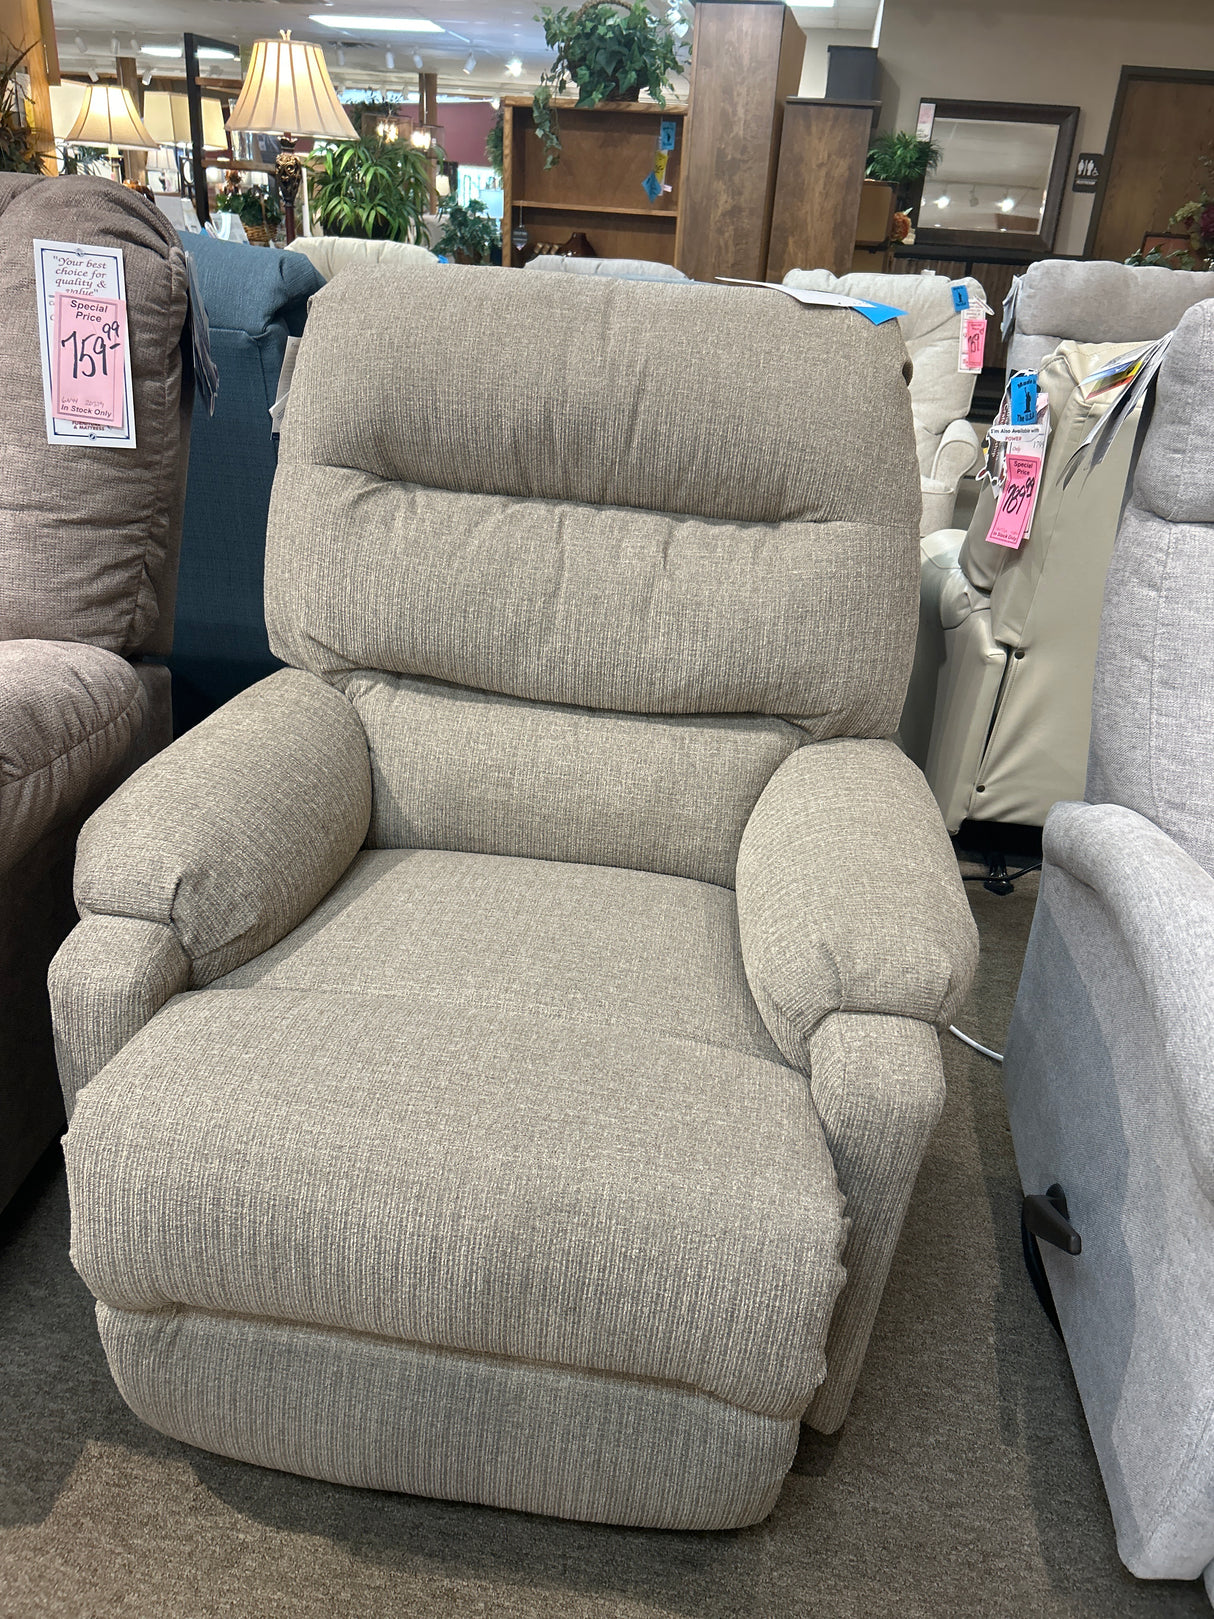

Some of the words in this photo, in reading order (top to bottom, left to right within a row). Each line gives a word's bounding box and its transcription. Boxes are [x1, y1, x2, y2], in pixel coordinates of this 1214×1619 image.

[53, 255, 84, 267] "Your
[86, 259, 106, 269] best
[55, 267, 88, 277] choice
[90, 270, 107, 280] for
[55, 277, 93, 289] quality
[96, 280, 107, 289] &
[70, 300, 108, 313] Special
[75, 311, 102, 322] Price
[70, 405, 92, 414] Stock
[94, 408, 112, 418] Only
[1014, 460, 1033, 469] Special
[1016, 468, 1030, 476] Price
